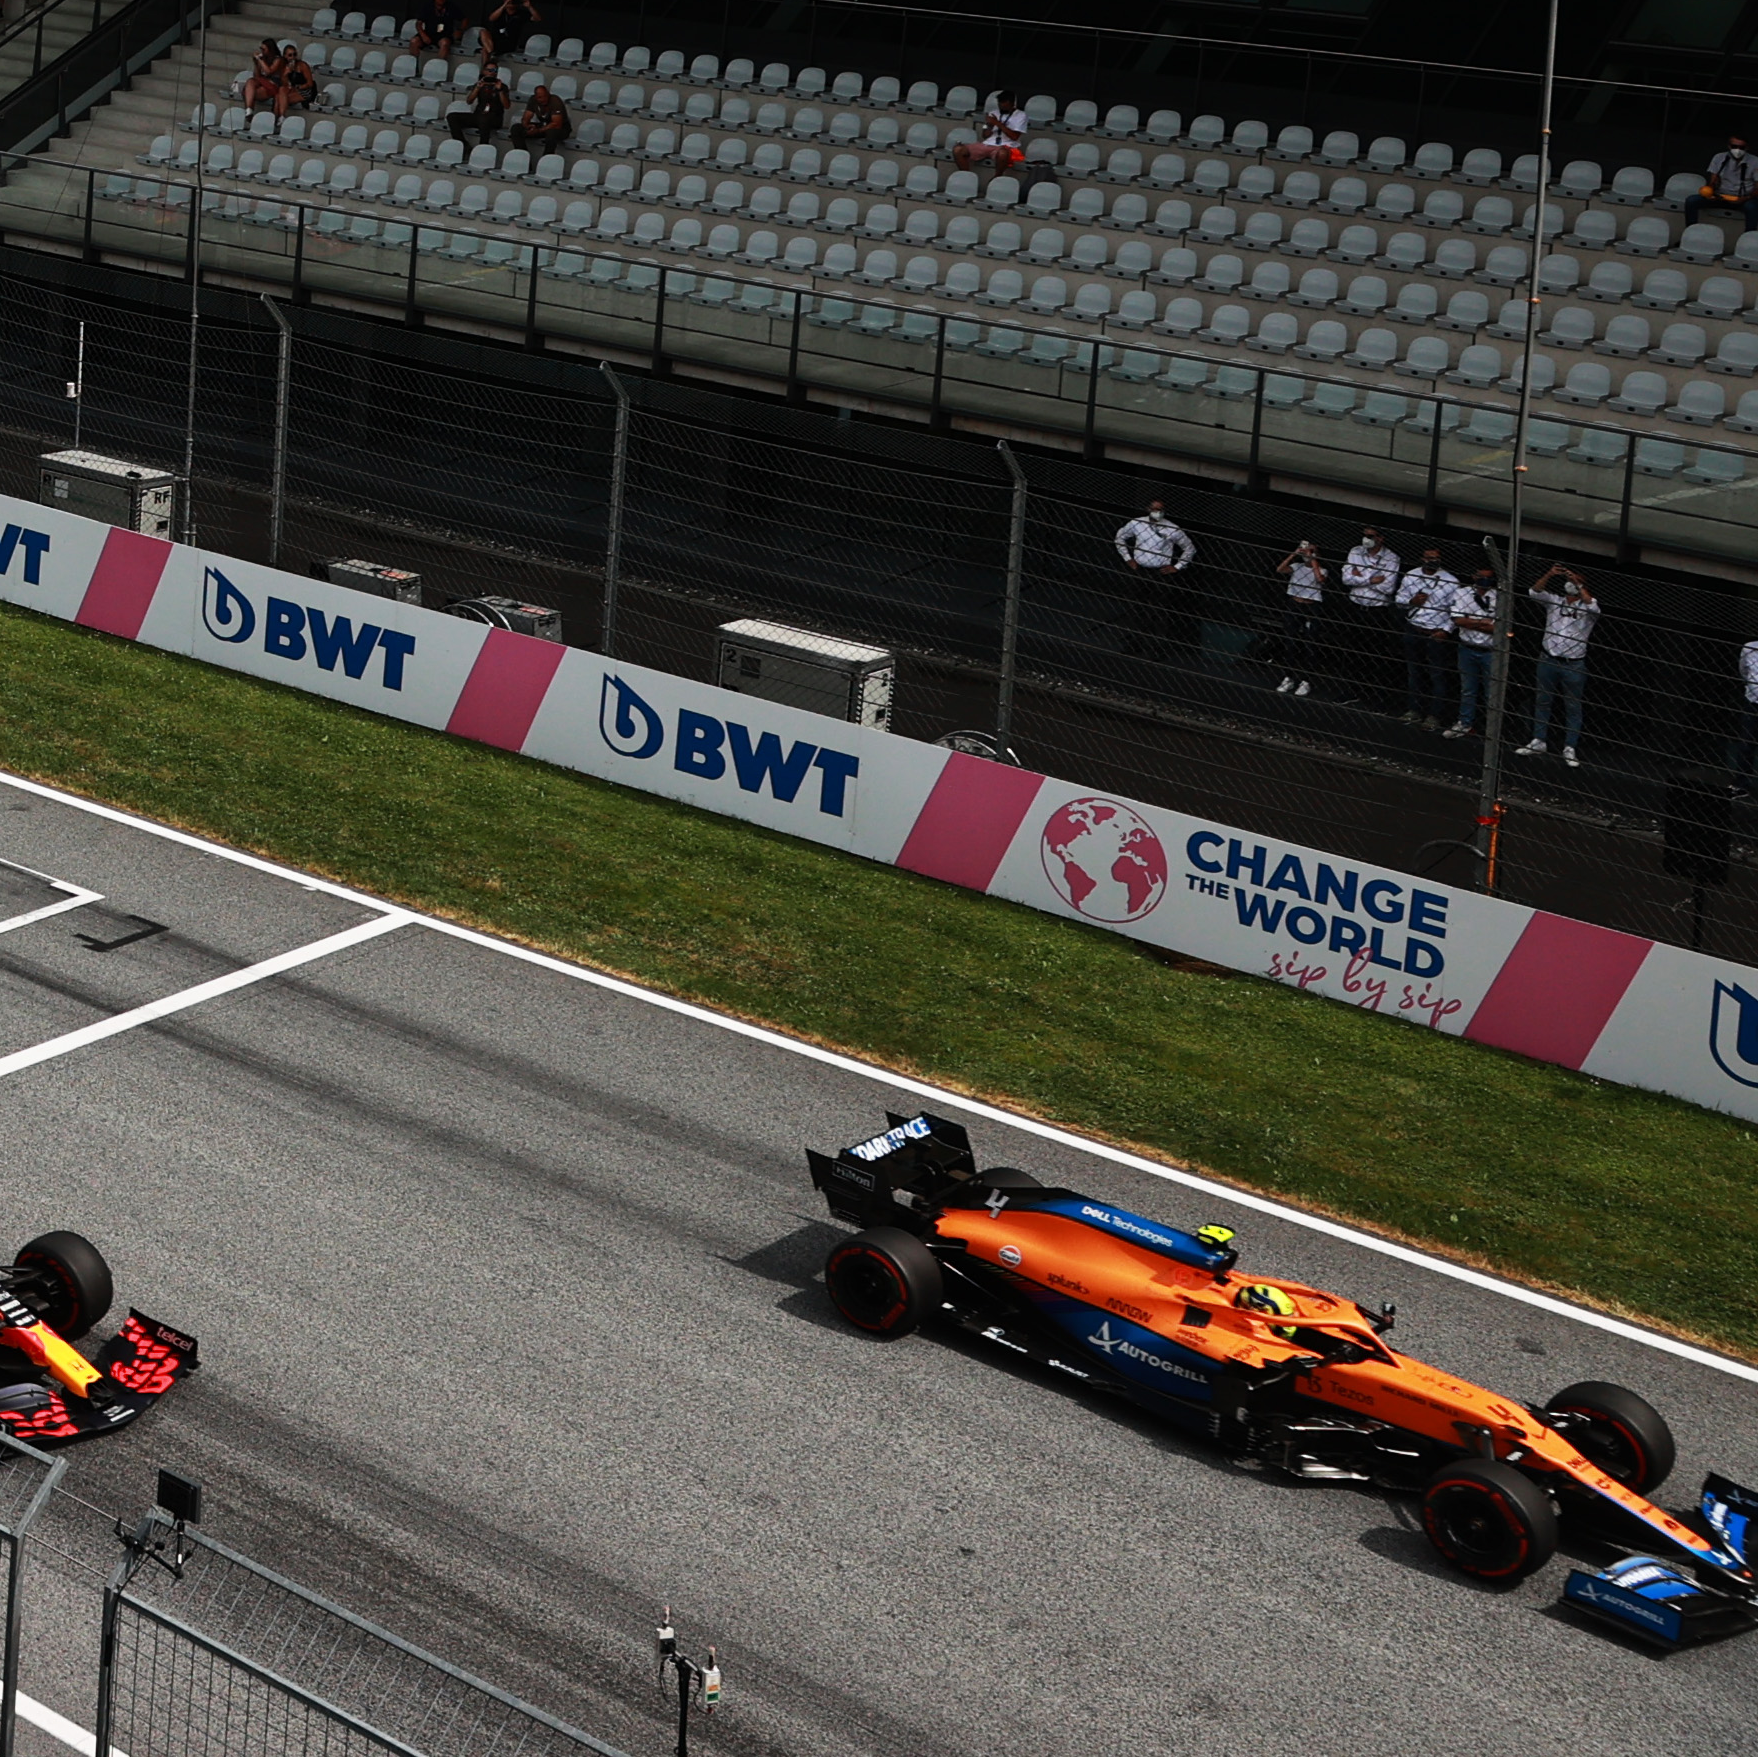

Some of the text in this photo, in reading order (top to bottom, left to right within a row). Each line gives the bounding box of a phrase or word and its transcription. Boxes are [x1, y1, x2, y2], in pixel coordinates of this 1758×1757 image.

[265, 596, 416, 691] BWT
[675, 708, 859, 817] BWT
[1184, 830, 1450, 939] CHANGE
[1185, 873, 1445, 979] THE WORLD
[1268, 946, 1462, 1031] sip by sip
[836, 1166, 871, 1188] Hilton
[986, 1188, 1011, 1219] 4
[1082, 1205, 1174, 1248] DELL Technologies
[1105, 1297, 1153, 1323] ARROW
[156, 1326, 193, 1352] telcel
[1118, 1341, 1208, 1384] AUTOGRILL
[1330, 1381, 1375, 1406] Tezos
[1601, 1593, 1665, 1626] AUTOGRILL
